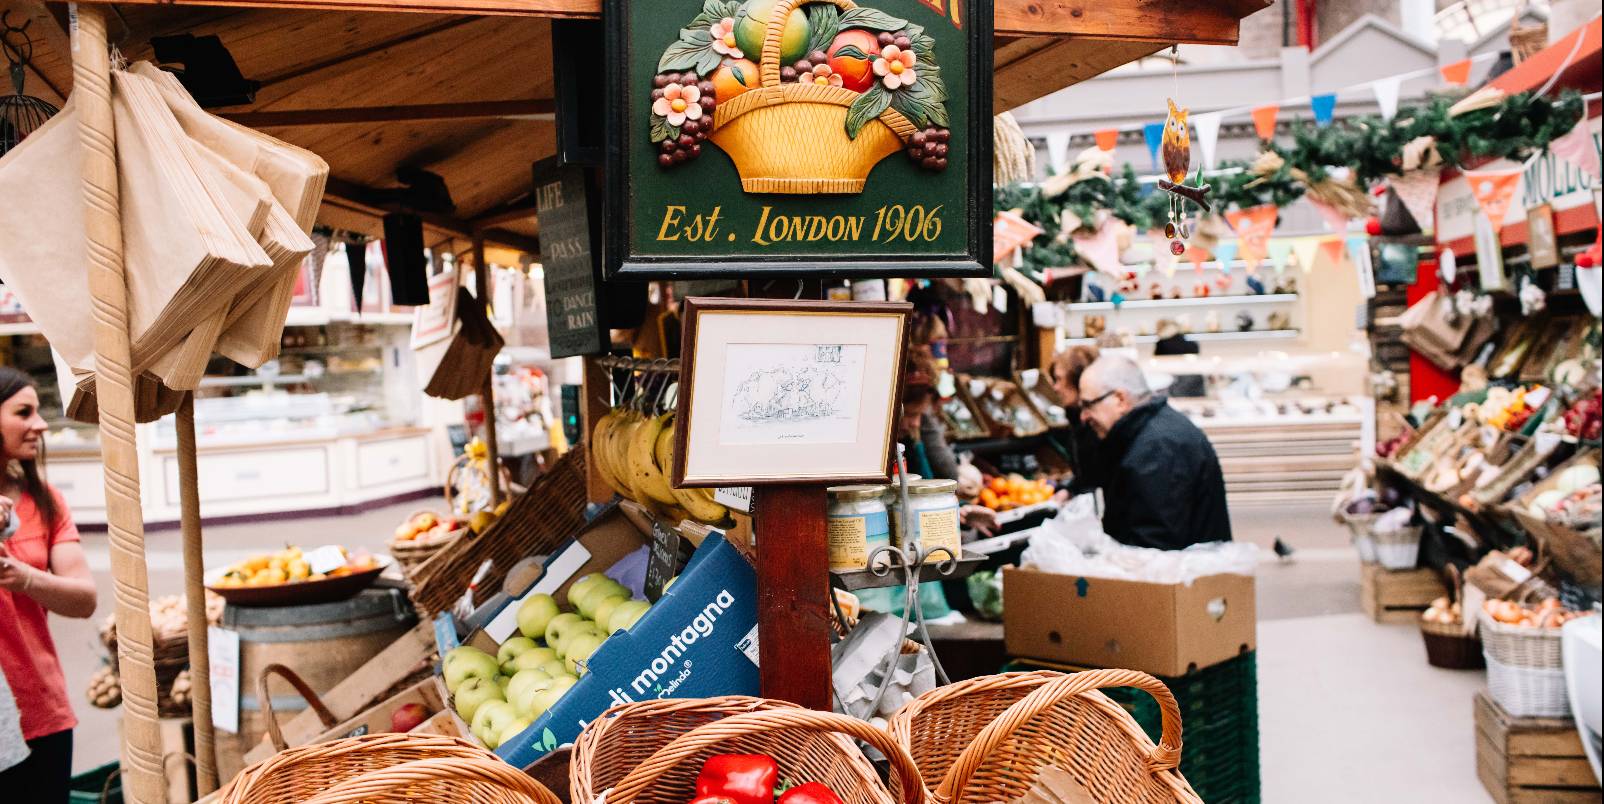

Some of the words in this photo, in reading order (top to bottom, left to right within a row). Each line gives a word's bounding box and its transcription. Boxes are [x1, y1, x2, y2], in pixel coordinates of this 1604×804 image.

[536, 182, 563, 211] LIFE
[871, 203, 945, 243] 1906
[551, 238, 583, 263] PASS
[568, 311, 593, 329] RAIN
[631, 589, 735, 695] montagna
